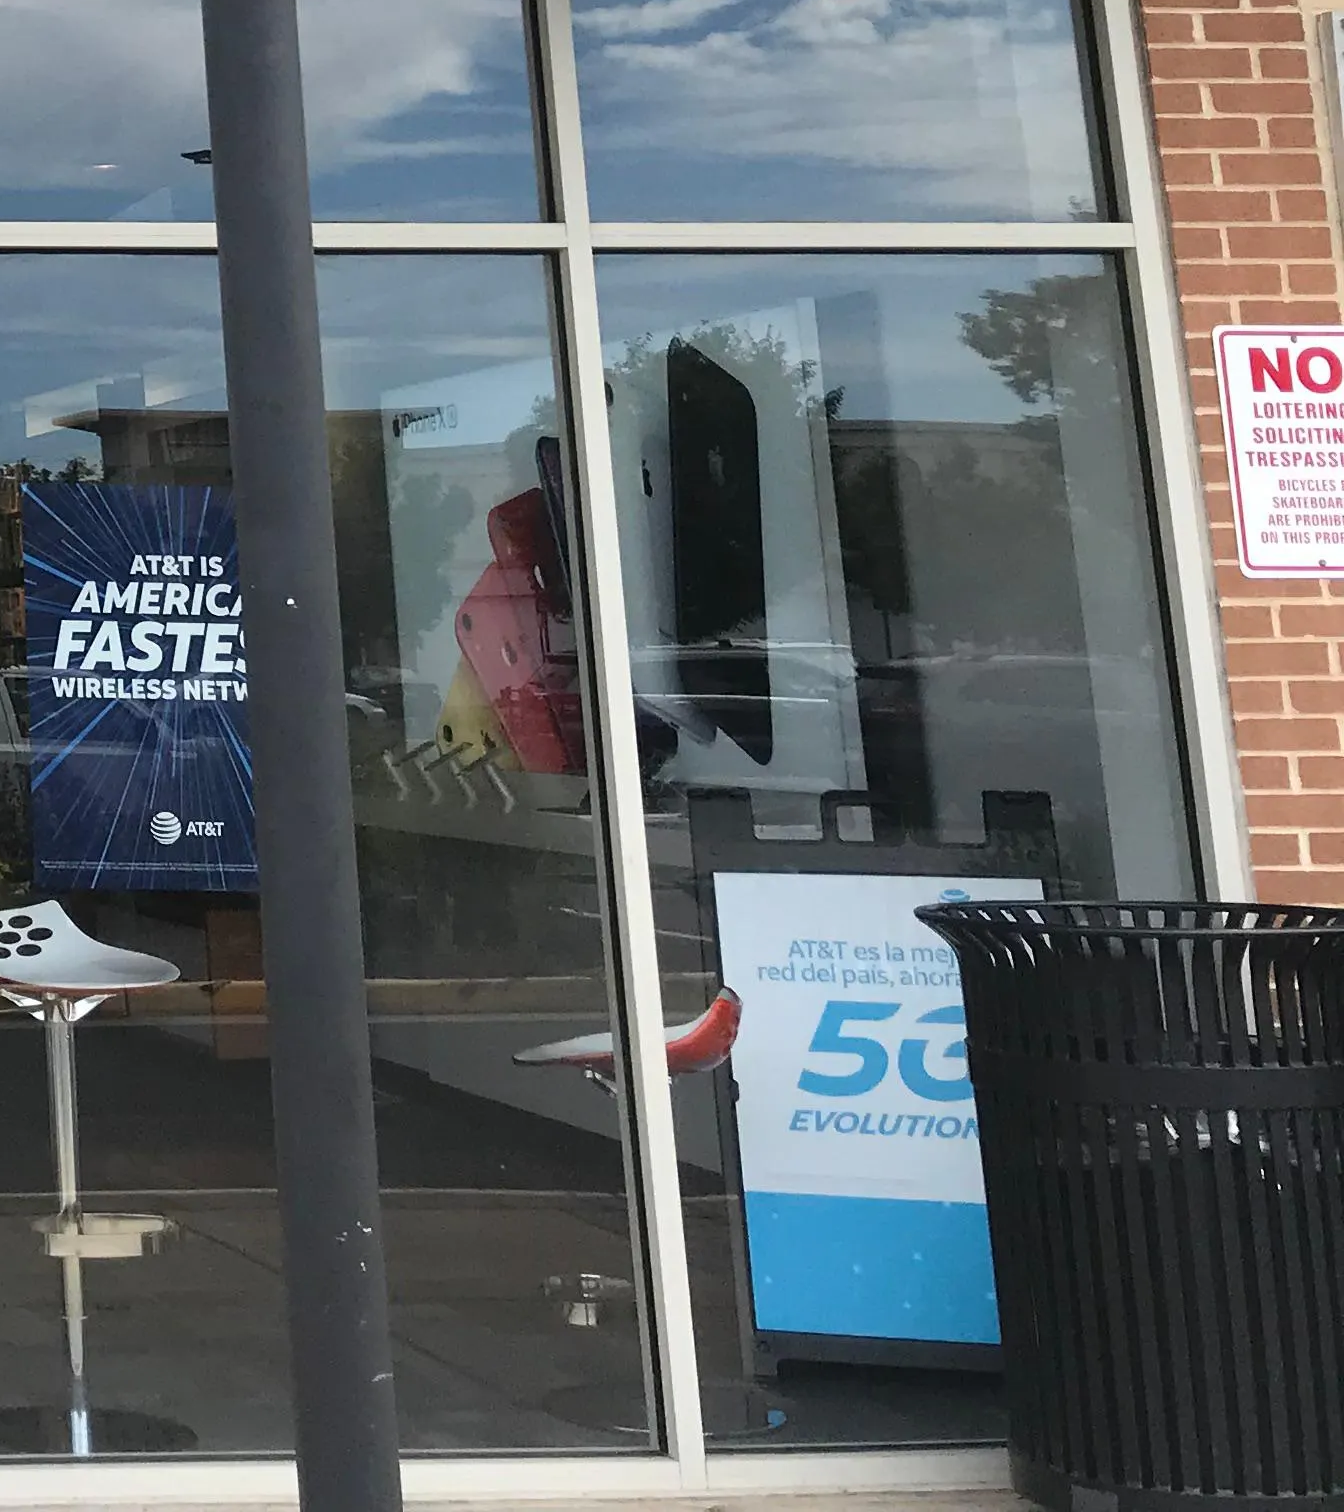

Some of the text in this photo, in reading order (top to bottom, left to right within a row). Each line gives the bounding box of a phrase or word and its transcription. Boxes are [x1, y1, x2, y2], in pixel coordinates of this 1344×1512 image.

[1248, 347, 1344, 394] NO
[1252, 427, 1344, 444] SOLICITIN
[1278, 479, 1336, 492] BICYCLES
[1268, 514, 1291, 527] ARE
[1261, 531, 1278, 544] ON
[1282, 532, 1311, 545] THIS
[130, 554, 224, 577] AT&T IS
[53, 619, 248, 674] FASTE
[51, 677, 177, 700] WIRELESS
[185, 820, 225, 837] AT&T
[788, 940, 848, 960] AT&T
[853, 945, 880, 961] es
[886, 941, 905, 961] la
[757, 963, 795, 982] red
[801, 963, 837, 983] del
[797, 1000, 975, 1103] 5G
